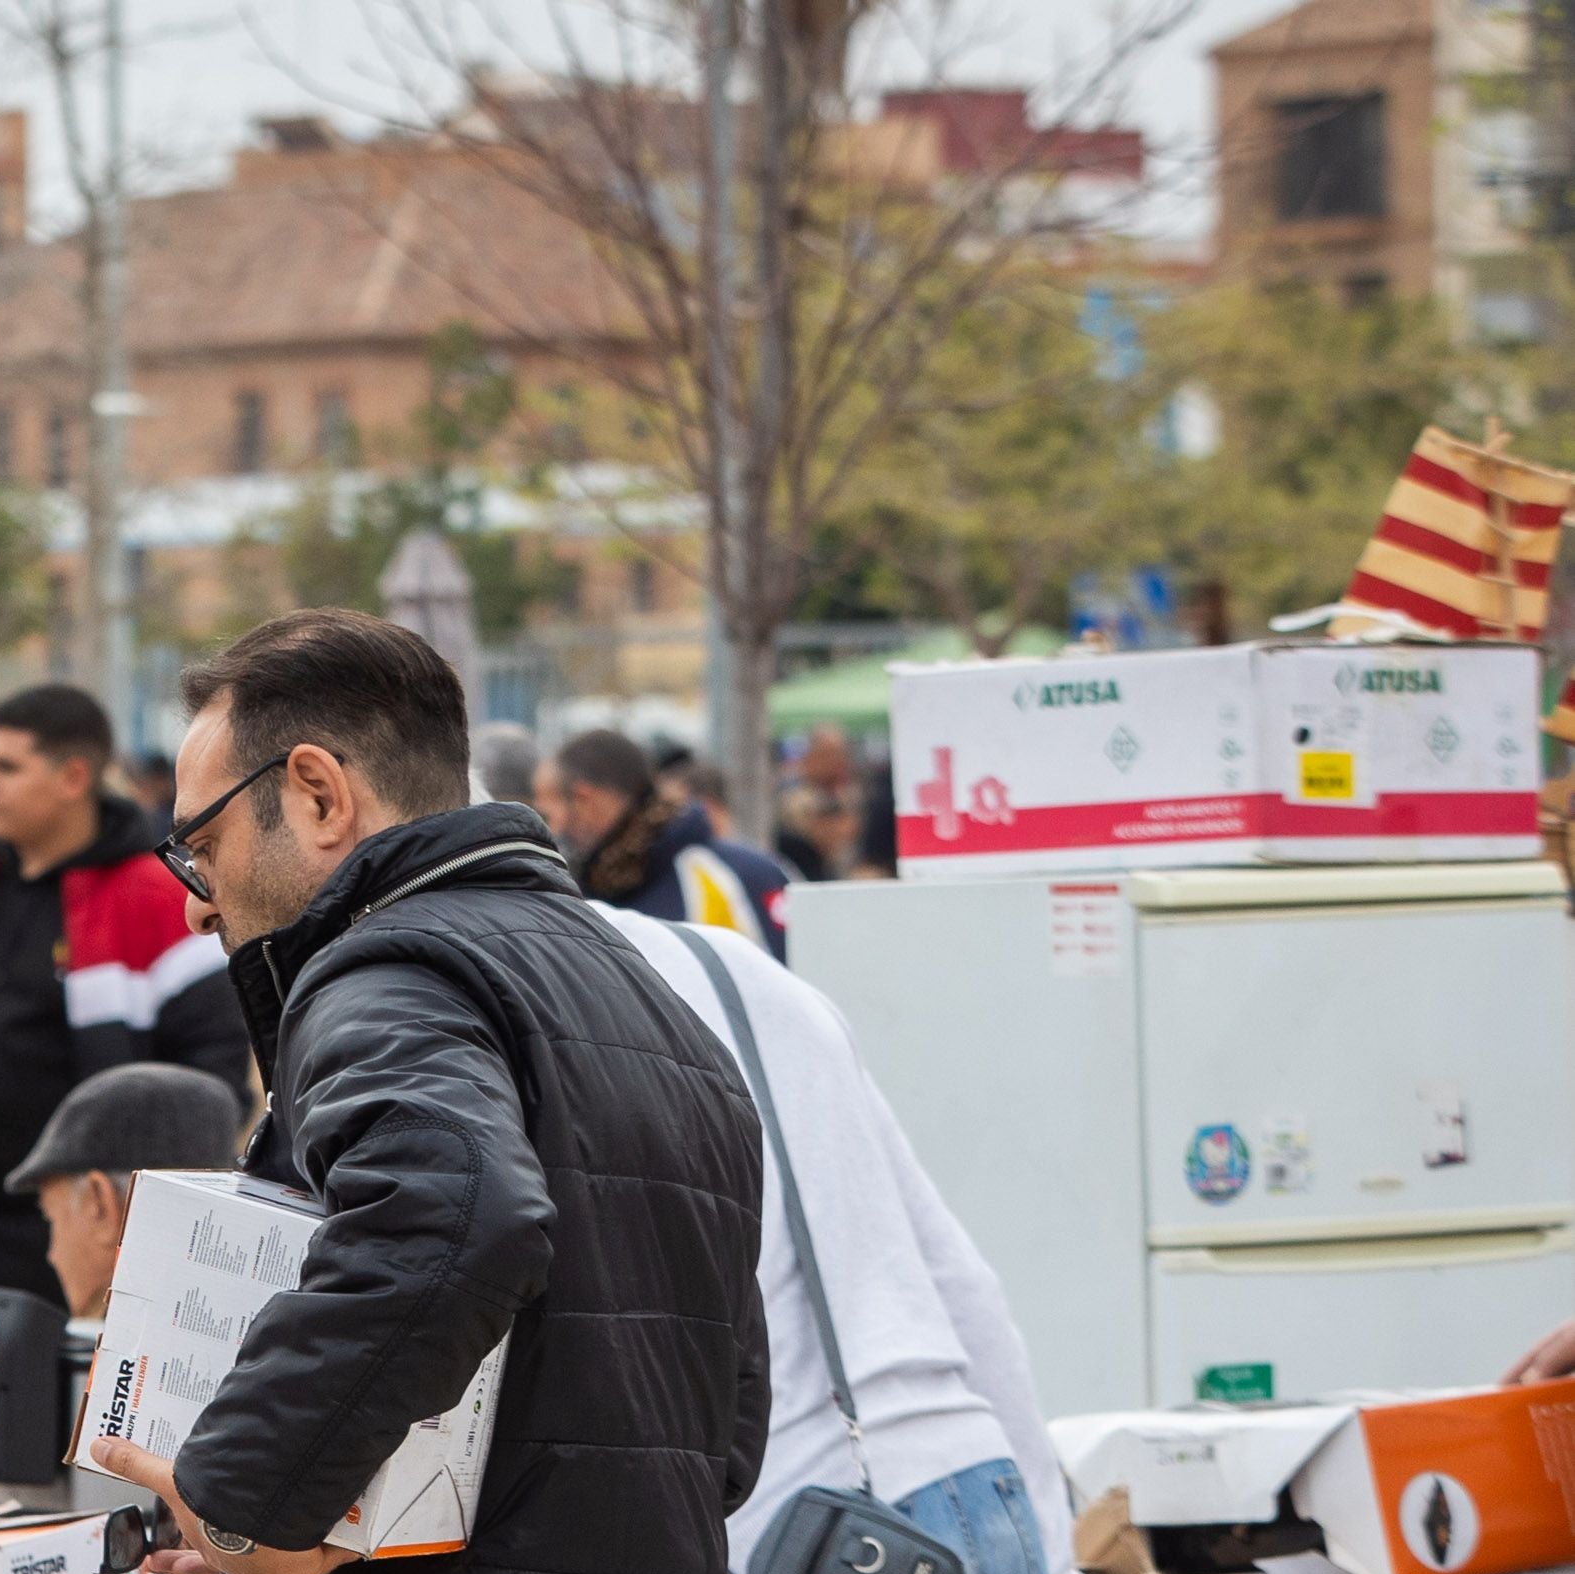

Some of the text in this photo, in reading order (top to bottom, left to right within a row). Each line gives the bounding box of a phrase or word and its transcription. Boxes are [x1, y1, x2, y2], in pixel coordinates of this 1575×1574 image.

[1038, 678, 1122, 708] ATUSA
[1360, 667, 1441, 694] ATUSA
[135, 1355, 149, 1387] BLENDER
[103, 1359, 135, 1438] RISTAR
